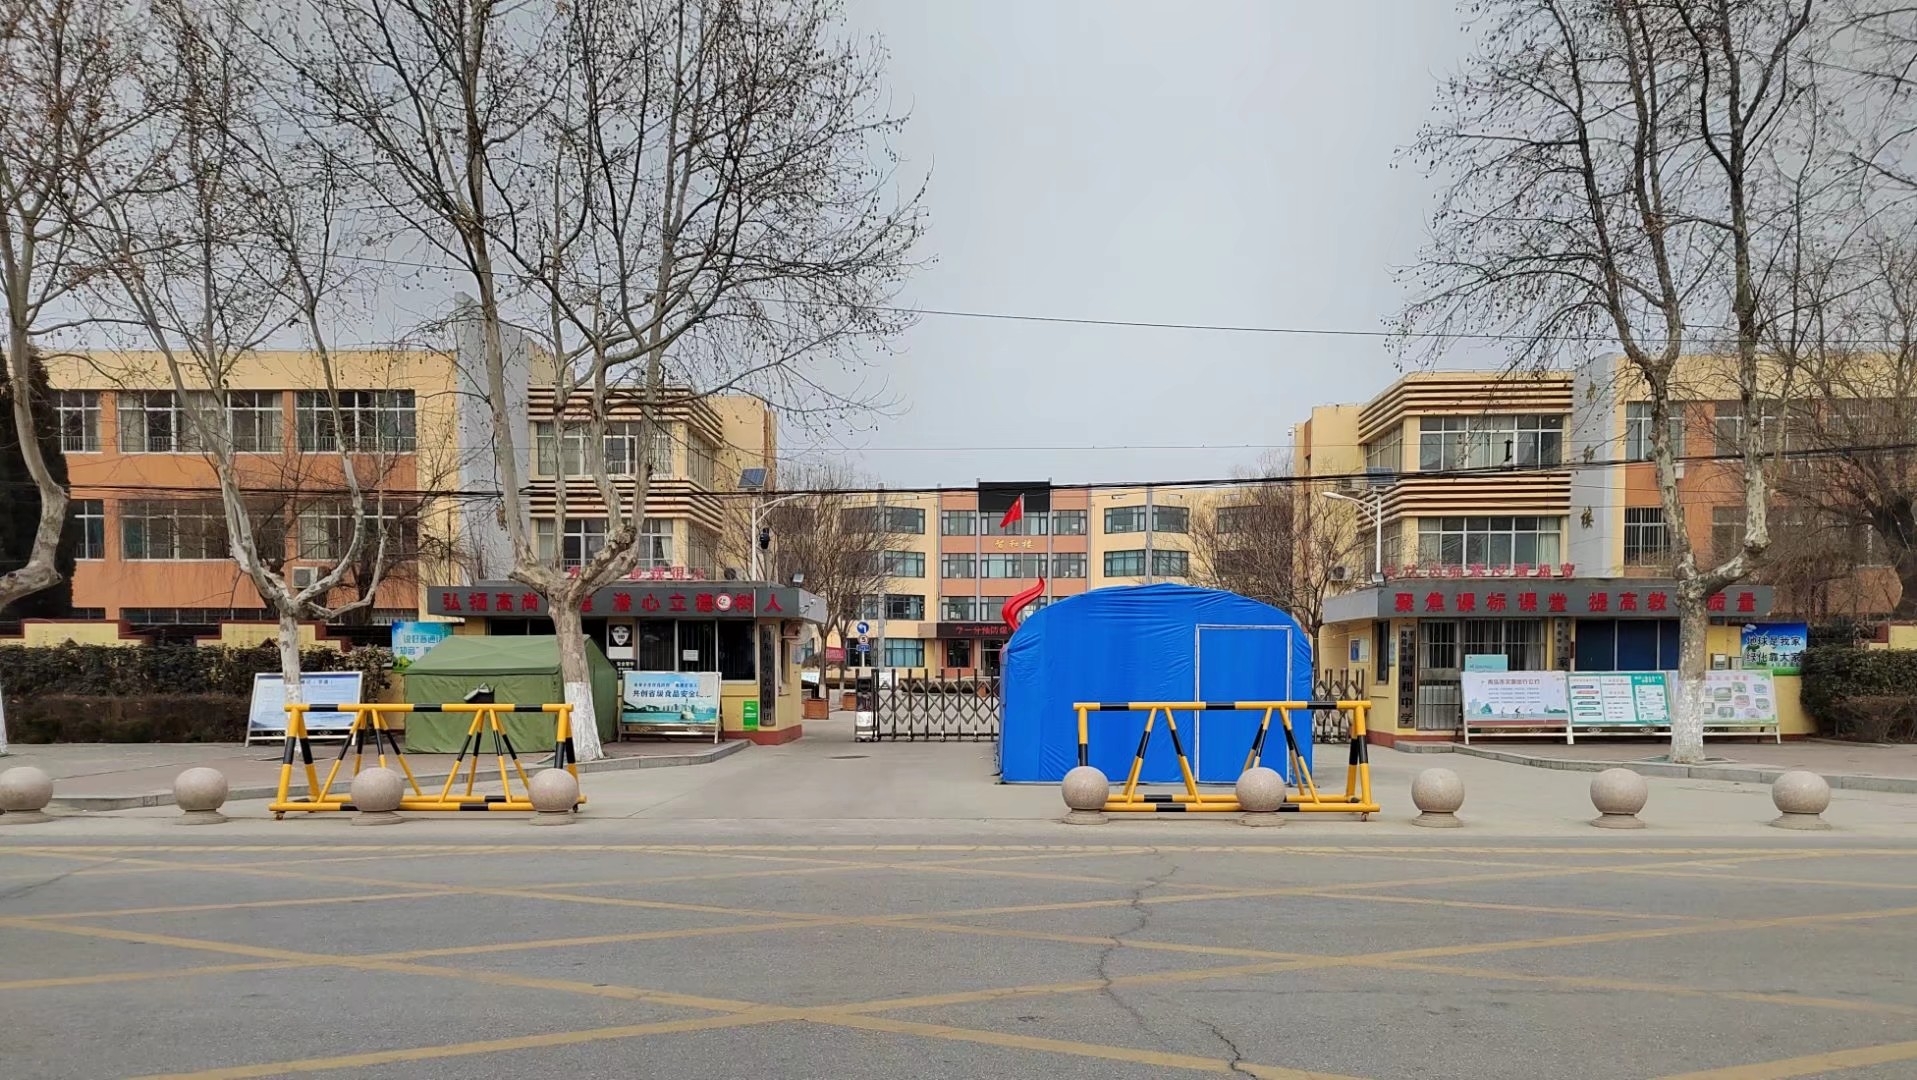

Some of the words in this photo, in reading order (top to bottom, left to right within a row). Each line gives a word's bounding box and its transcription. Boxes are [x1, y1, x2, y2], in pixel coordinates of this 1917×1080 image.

[443, 592, 593, 612] 弘扬高尚德
[612, 592, 784, 612] 潜心立德树人
[1394, 591, 1568, 613] 聚焦课标课堂
[1588, 591, 1757, 613] 提高教质量
[1746, 634, 1801, 648] 地球是我家
[1746, 651, 1801, 663] 绿化靠大家
[633, 689, 713, 698] 共创省级食品安全
[1401, 665, 1413, 724] 同和中学
